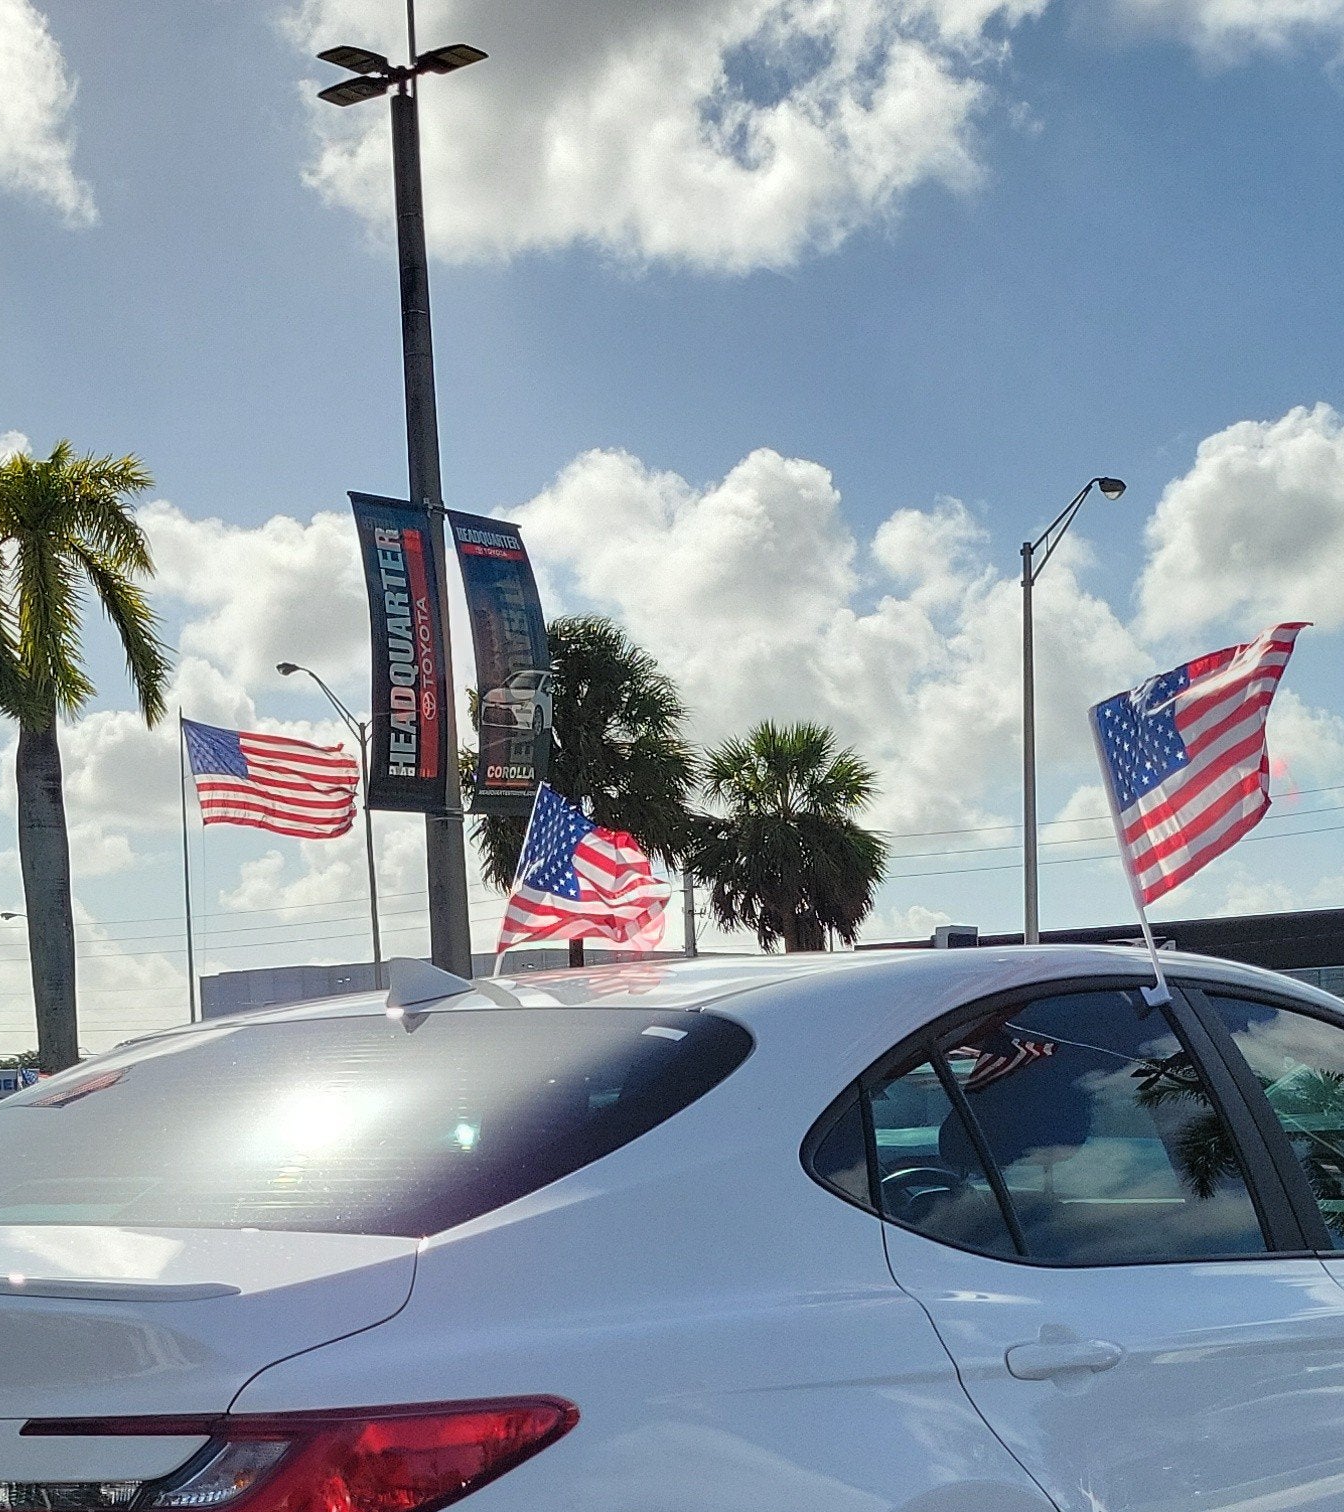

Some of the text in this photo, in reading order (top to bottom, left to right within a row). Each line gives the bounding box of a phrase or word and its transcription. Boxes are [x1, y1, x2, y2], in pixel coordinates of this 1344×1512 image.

[456, 527, 520, 550] HEADQUARTER
[374, 528, 418, 777] HEADQUARTER
[416, 597, 434, 687] TOYOTA
[487, 764, 535, 780] COROLLA
